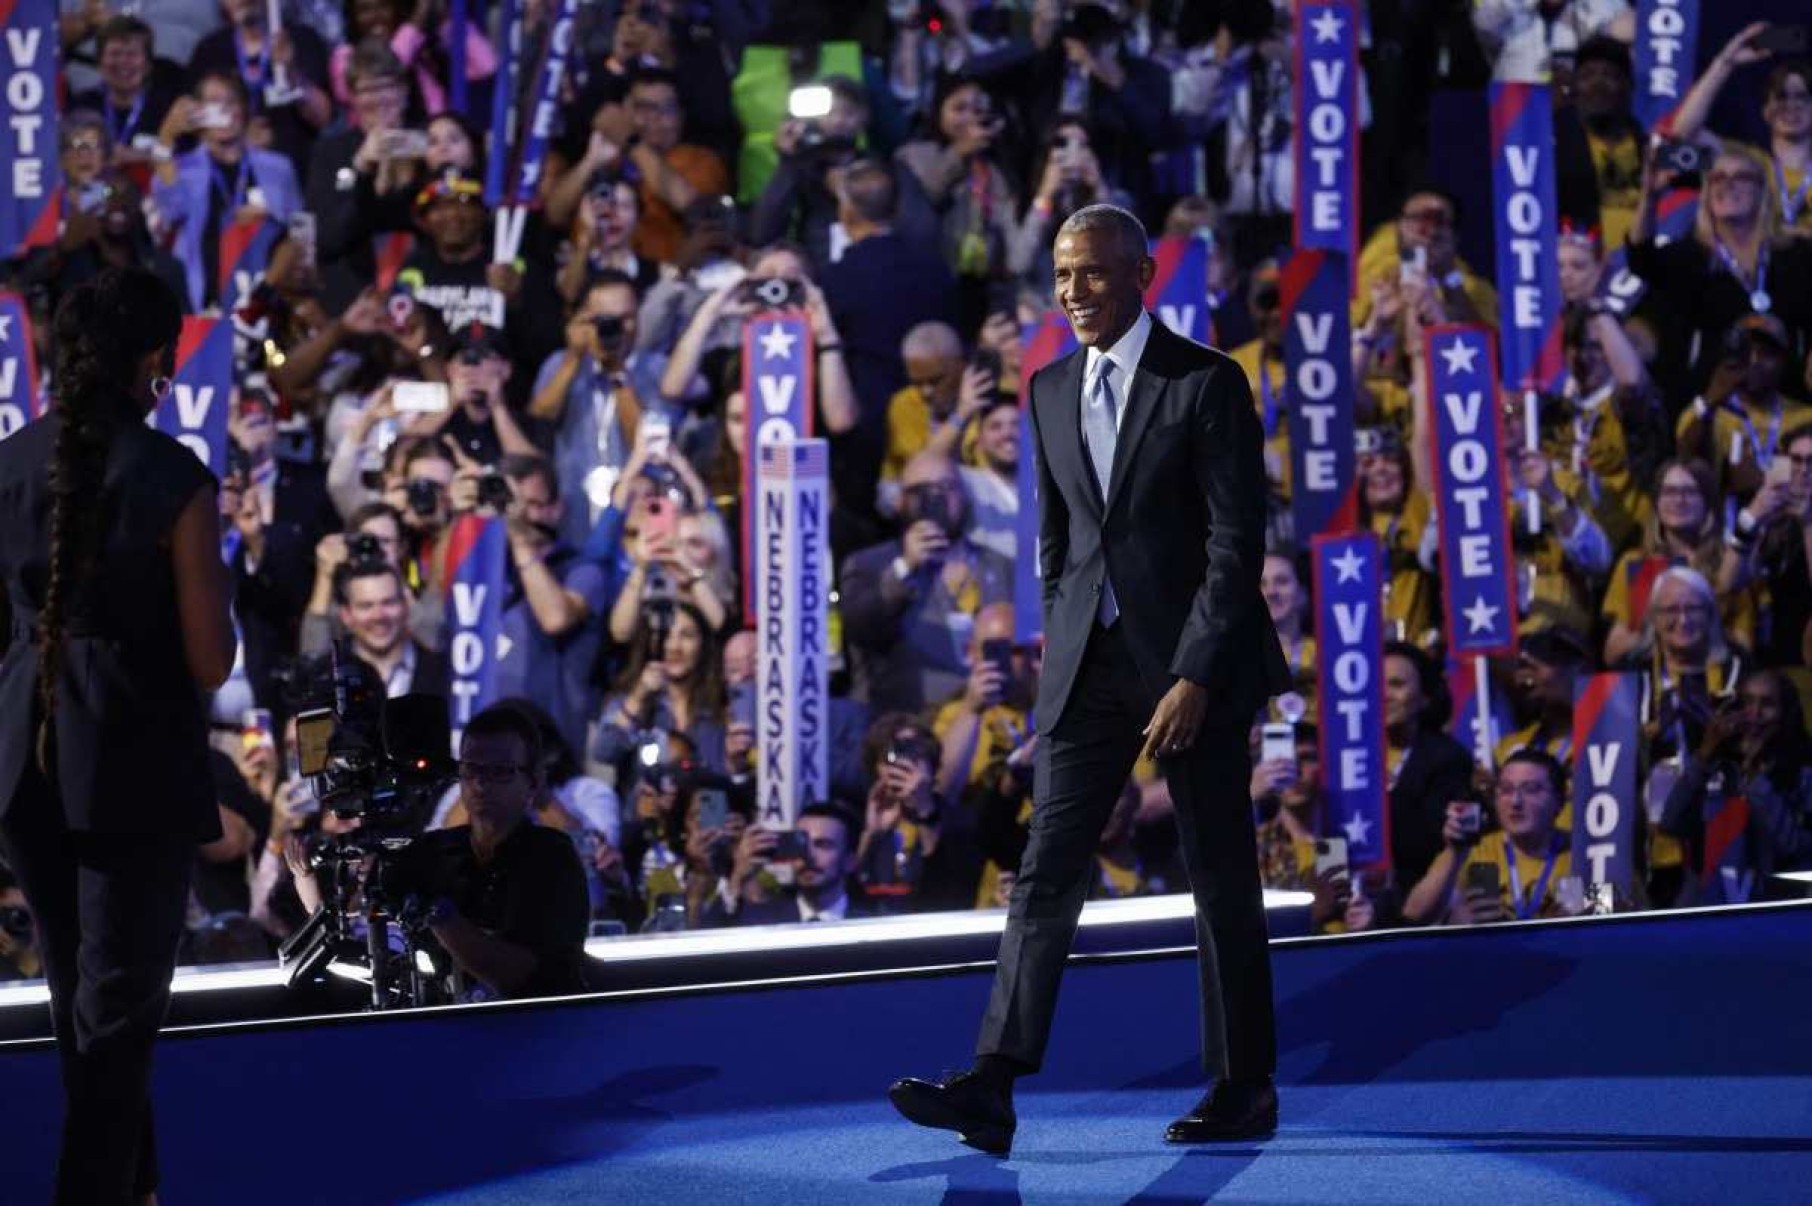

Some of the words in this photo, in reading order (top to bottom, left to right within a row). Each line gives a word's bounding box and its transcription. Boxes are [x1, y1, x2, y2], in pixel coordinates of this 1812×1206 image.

[8, 29, 42, 197] VOTE
[1649, 0, 1684, 96] OTE
[1311, 61, 1344, 230] VOTE
[1507, 146, 1541, 328] VOTE
[1297, 314, 1337, 490] VOTE
[1445, 393, 1493, 577] VOTE
[765, 491, 785, 822] NEBRASKA
[1333, 604, 1368, 790] VOTE
